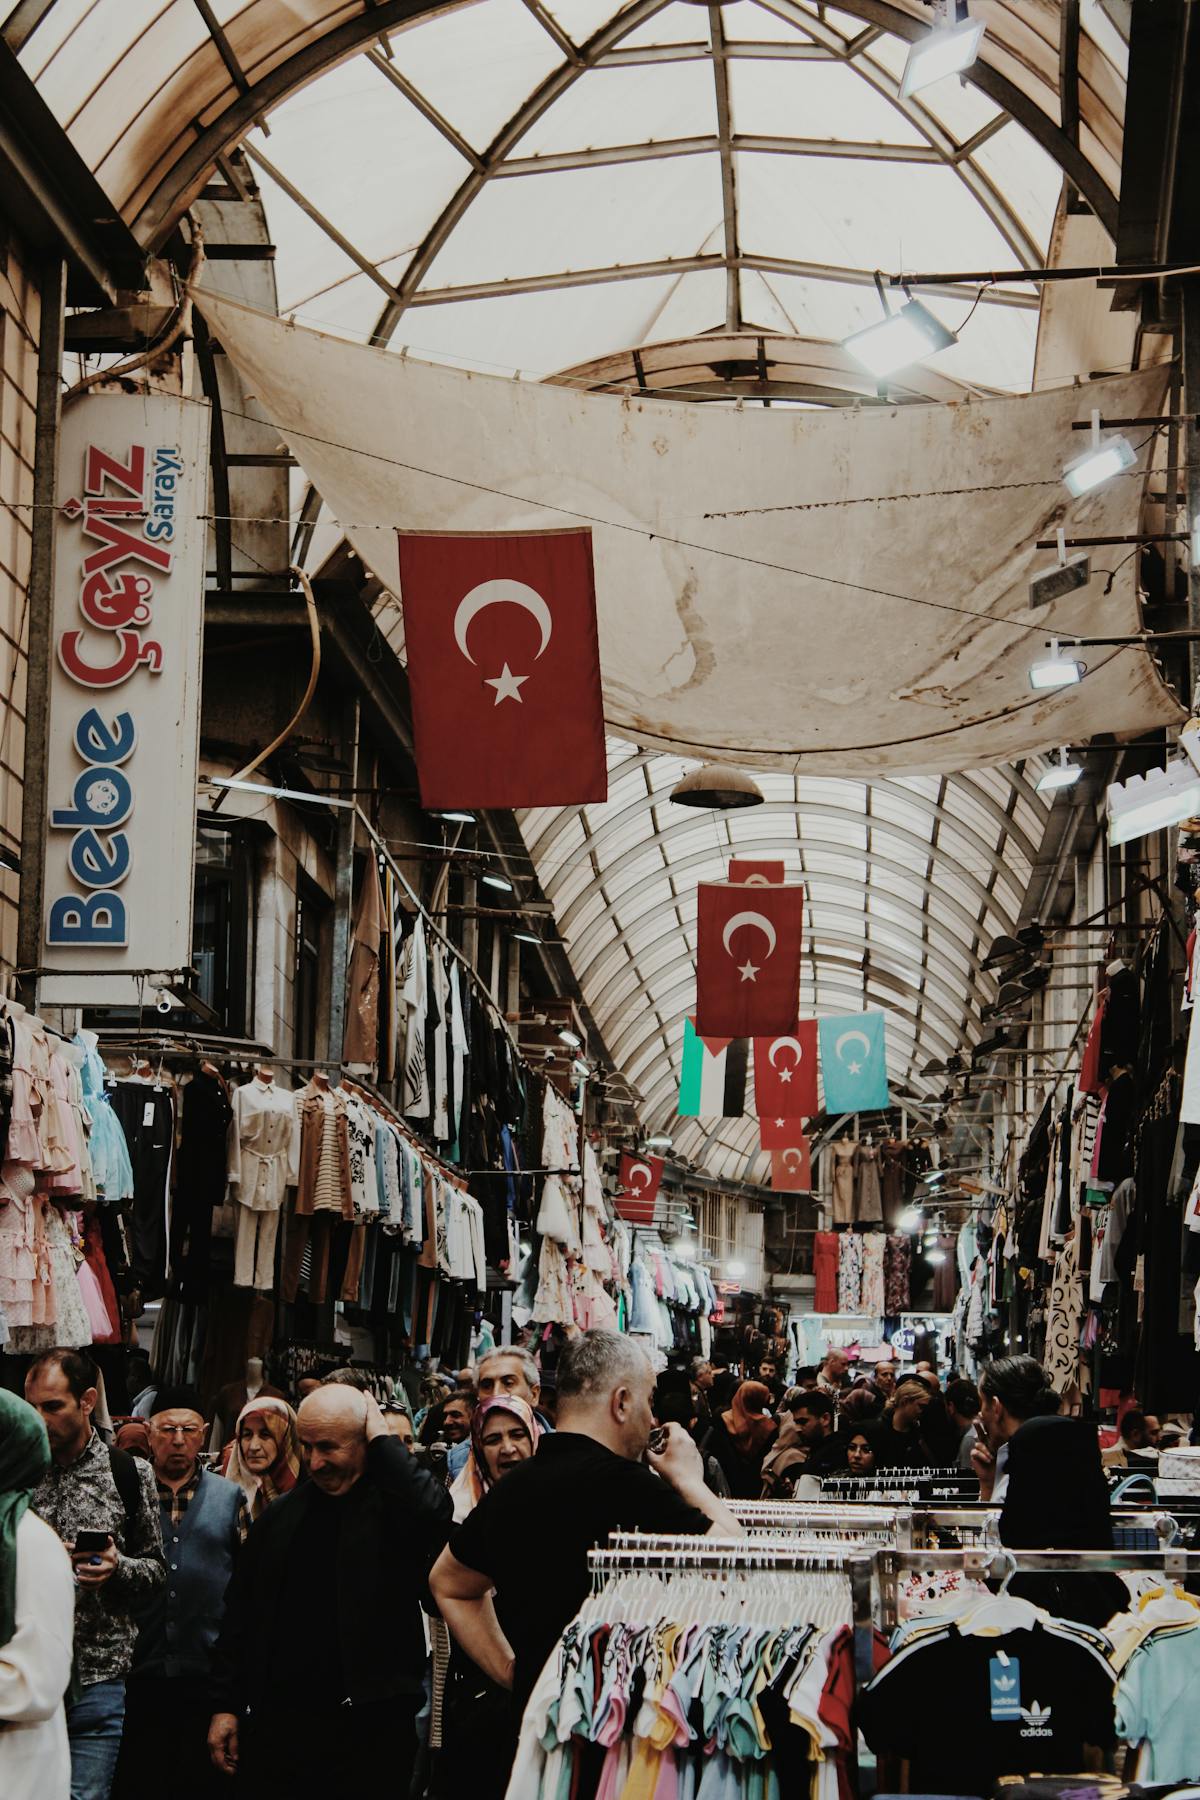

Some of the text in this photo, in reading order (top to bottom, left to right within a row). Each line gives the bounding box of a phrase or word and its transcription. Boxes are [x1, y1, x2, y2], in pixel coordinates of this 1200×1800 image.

[147, 449, 180, 538] Sarayı
[50, 445, 171, 943] Bebe Çeyiz
[1020, 1727, 1053, 1737] adidas
